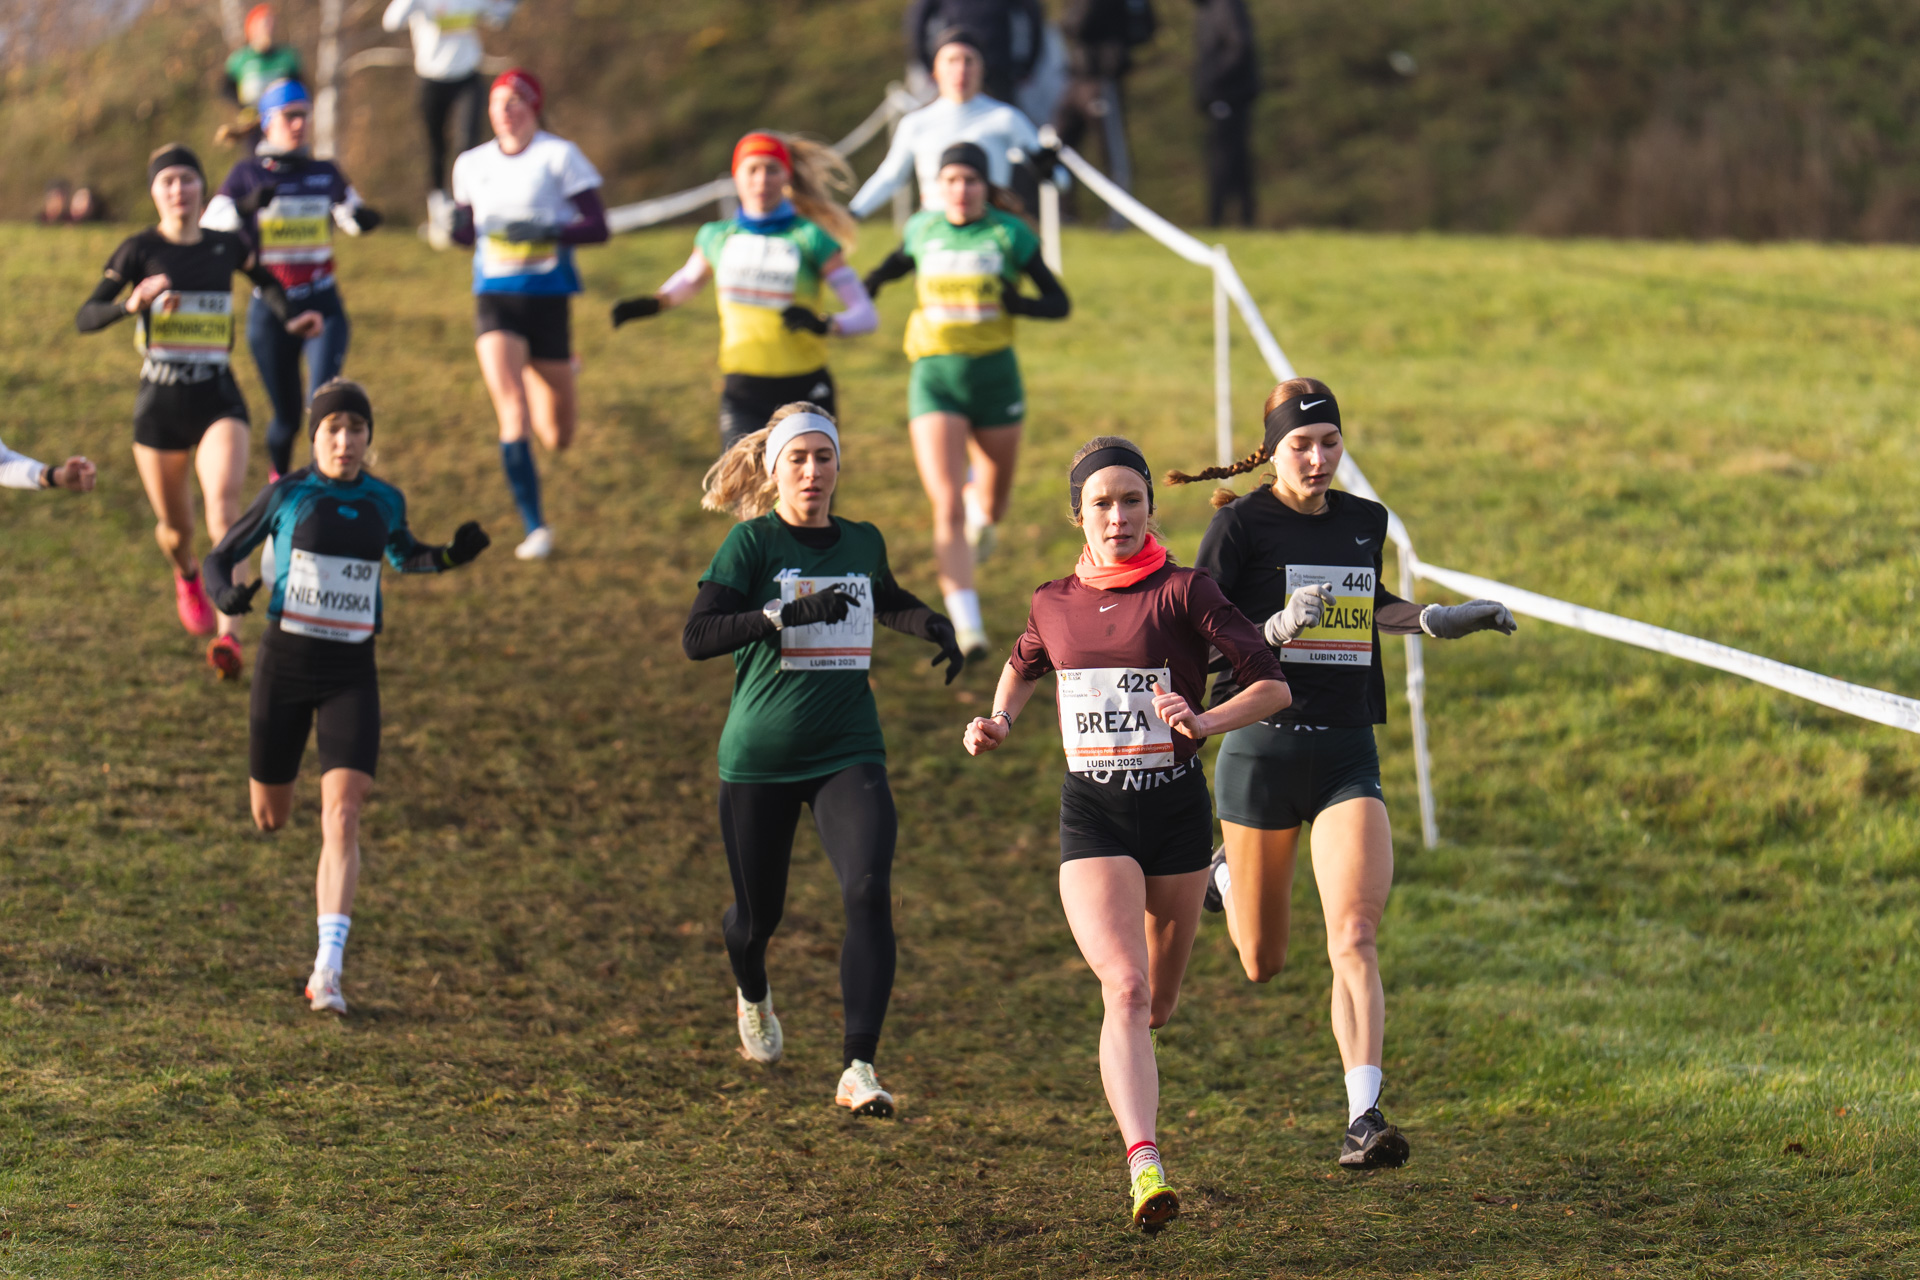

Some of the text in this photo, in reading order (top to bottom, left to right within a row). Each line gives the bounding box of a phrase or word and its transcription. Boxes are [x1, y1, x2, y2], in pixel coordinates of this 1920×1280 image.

[342, 563, 372, 582] 430
[1342, 572, 1372, 592] 440
[289, 583, 371, 613] NIEMYJSKA
[810, 659, 836, 667] LUBIN
[1310, 653, 1358, 662] LUBIN 2025
[1117, 673, 1159, 693] 428
[1075, 710, 1151, 734] BREZA
[1086, 758, 1143, 768] LUBIN 2025
[1121, 764, 1187, 791] NIKE
